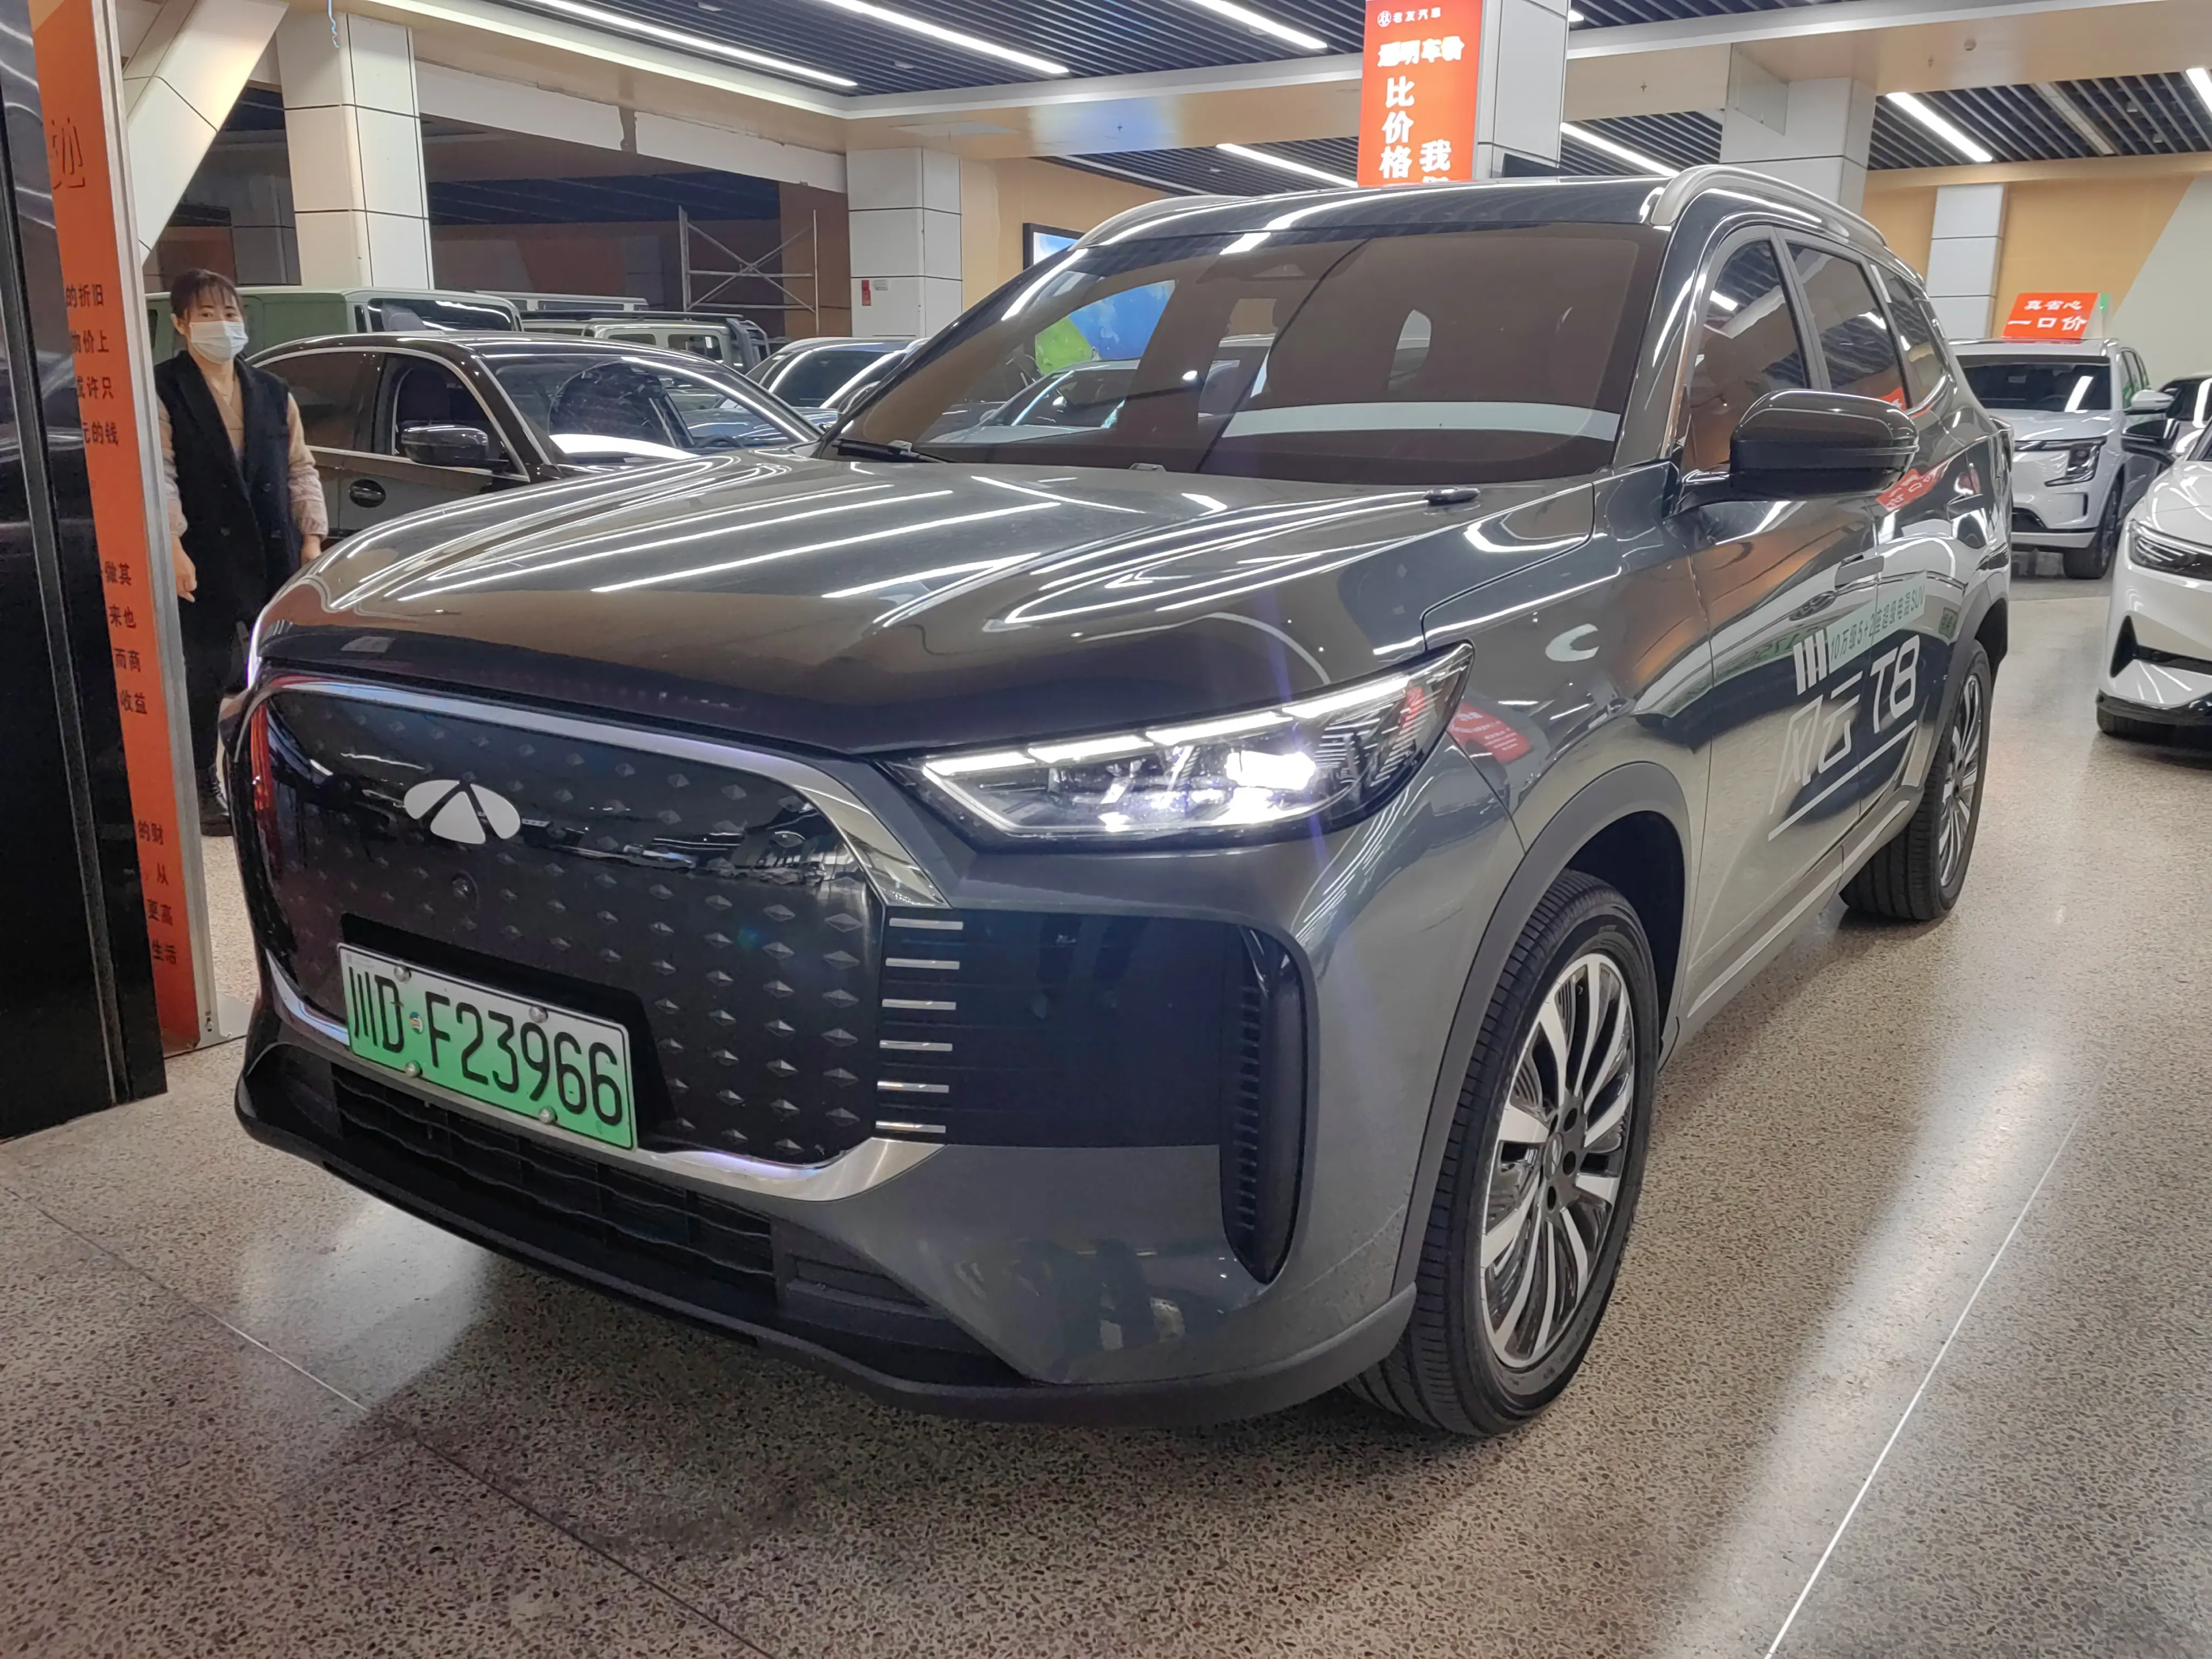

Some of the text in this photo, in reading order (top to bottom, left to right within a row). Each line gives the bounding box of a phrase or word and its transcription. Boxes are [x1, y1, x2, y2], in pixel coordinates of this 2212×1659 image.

[1379, 76, 1415, 178] 比价格
[2024, 300, 2083, 311] 真省心
[2007, 316, 2088, 331] 一口价
